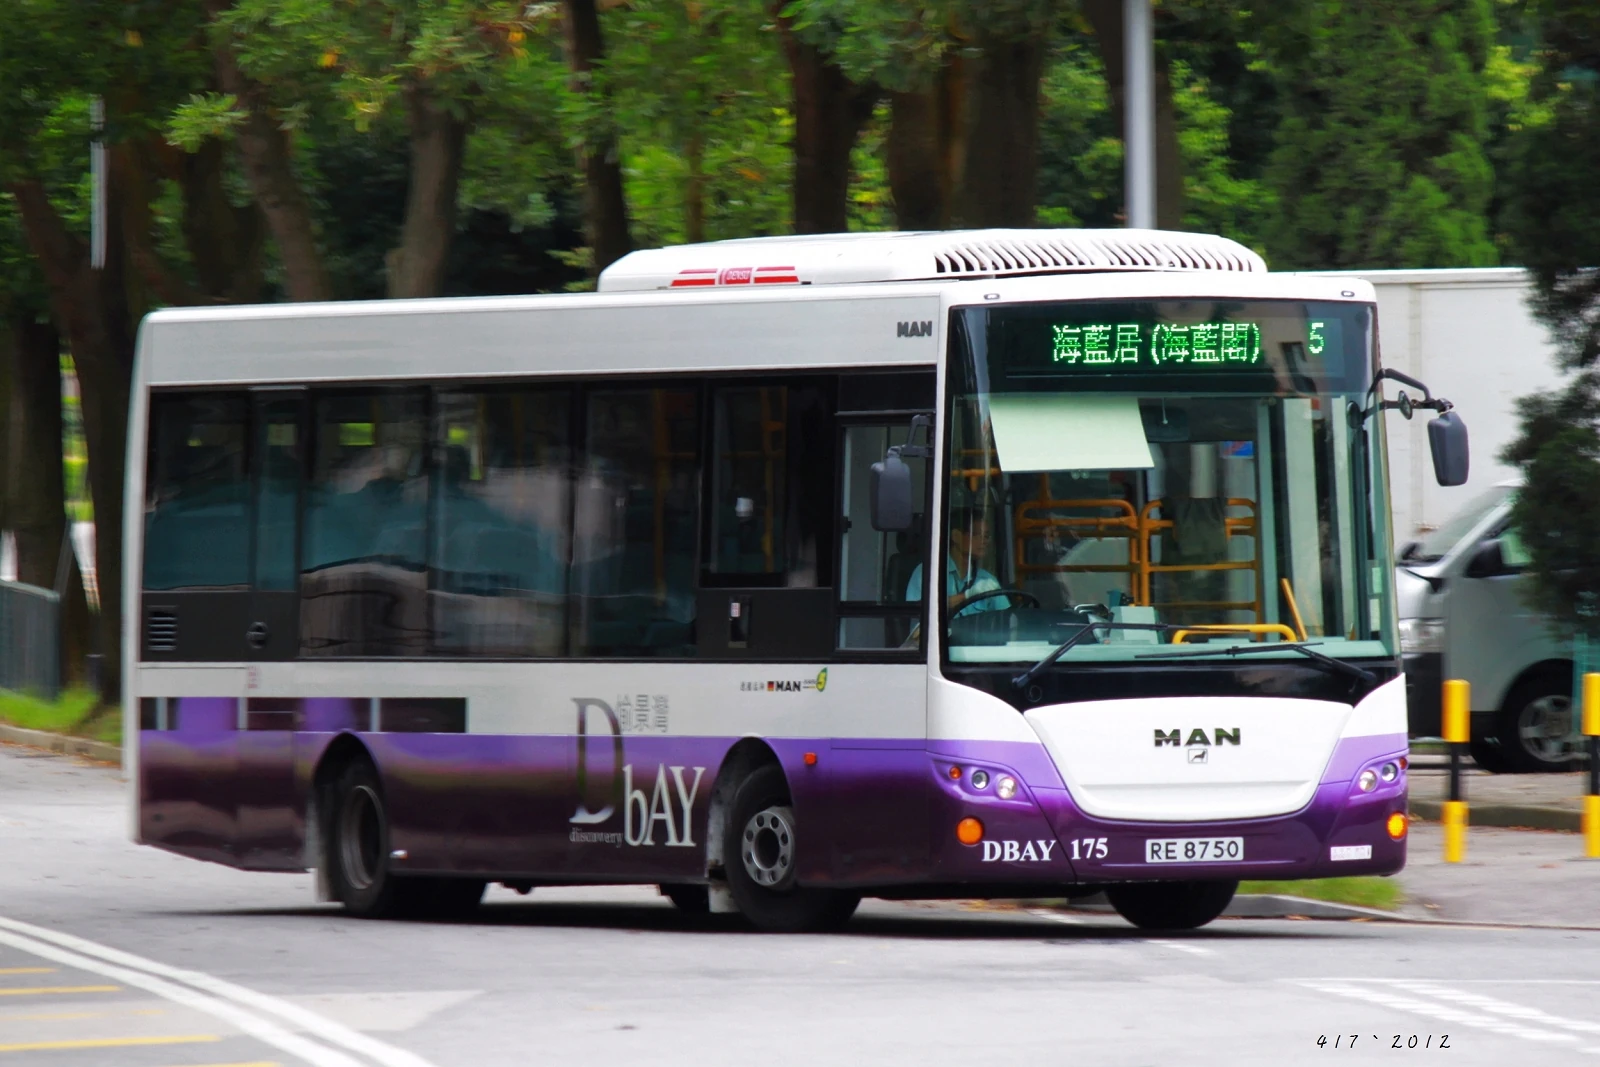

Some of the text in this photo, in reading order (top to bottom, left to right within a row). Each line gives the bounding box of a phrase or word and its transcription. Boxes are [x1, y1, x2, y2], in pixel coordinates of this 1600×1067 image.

[897, 321, 932, 338] MAN
[1308, 321, 1325, 354] 5
[775, 681, 802, 693] MAN
[1153, 727, 1242, 747] MAN
[981, 838, 1109, 863] DBAY 175
[1150, 840, 1240, 860] RE 8750
